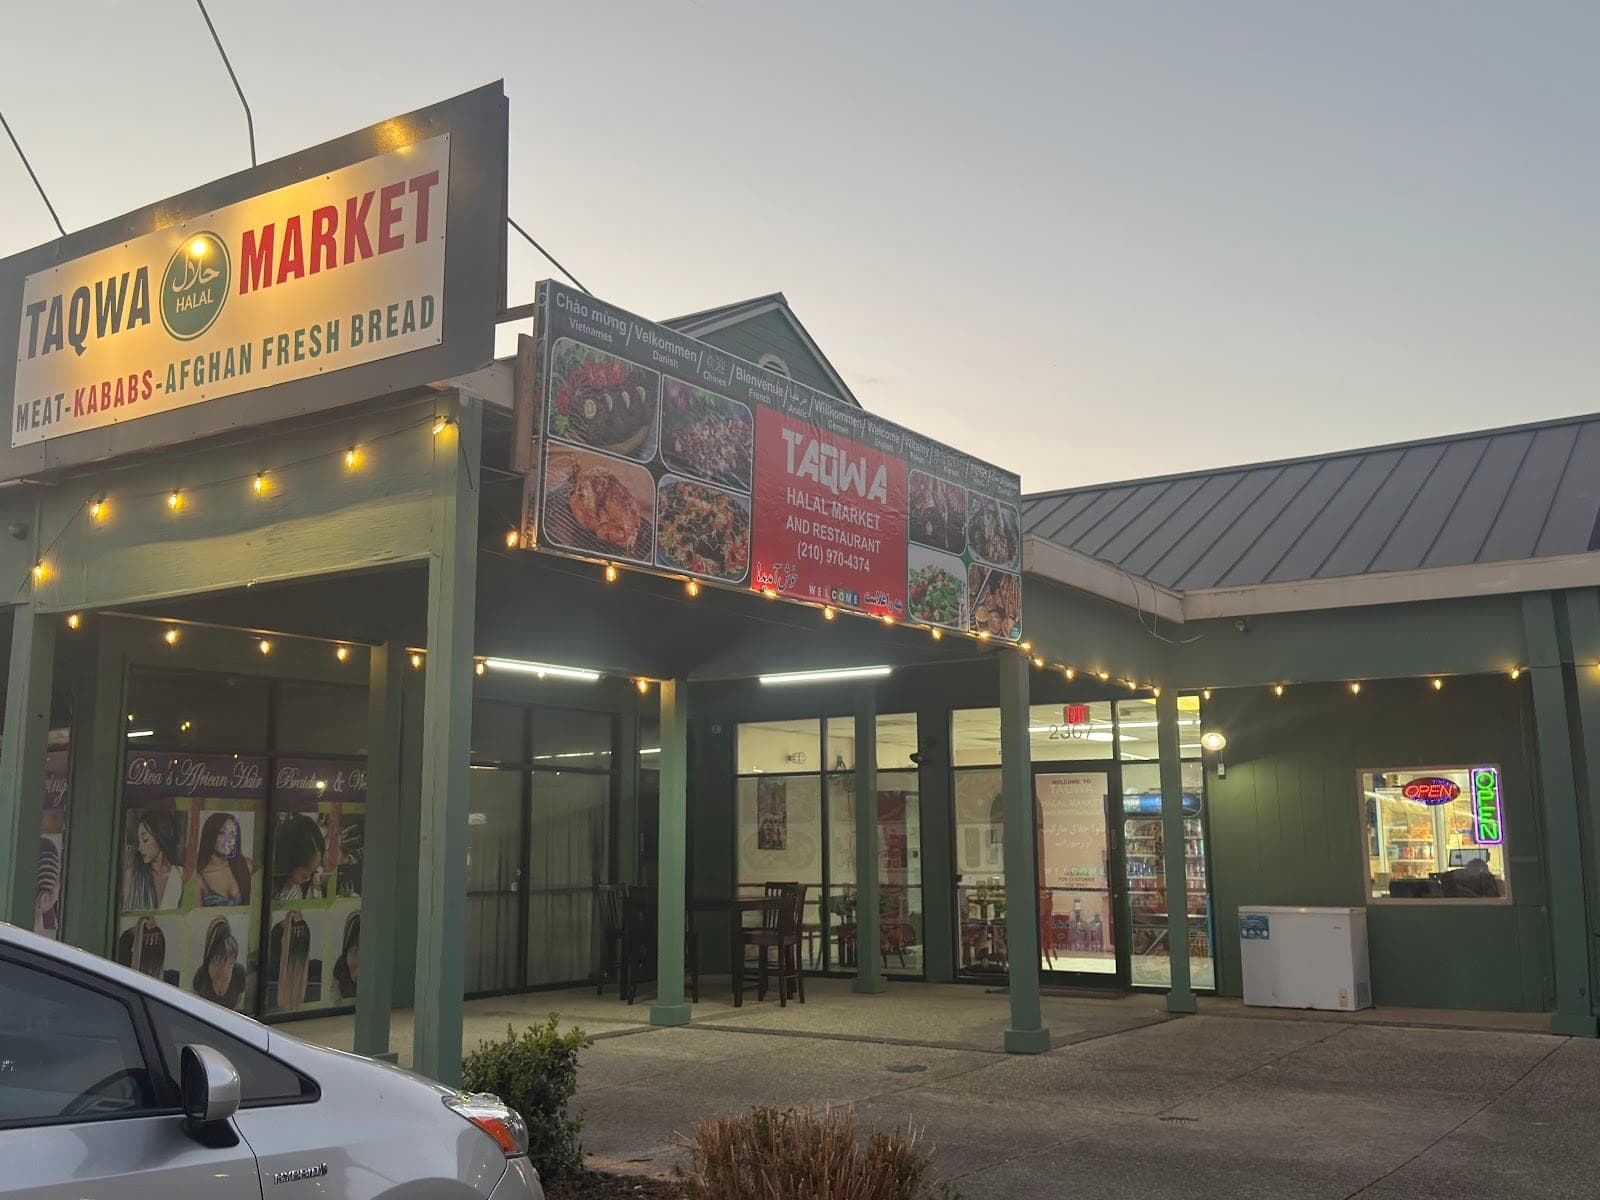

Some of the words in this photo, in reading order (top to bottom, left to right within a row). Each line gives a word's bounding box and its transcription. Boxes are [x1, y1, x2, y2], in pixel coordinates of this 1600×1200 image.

[25, 265, 151, 360] TAQWA
[239, 169, 439, 296] MARKET
[176, 288, 214, 314] HALAL
[262, 318, 341, 371] FRESH
[350, 294, 436, 348] BREAD
[652, 350, 679, 369] Danish
[782, 428, 888, 505] TAQWA
[787, 487, 829, 516] HALAL
[831, 500, 881, 531] MARKET
[786, 515, 810, 535] AND
[812, 522, 881, 553] RESTAURANT
[797, 541, 823, 565] (210)
[826, 550, 871, 573] 970-4374
[809, 584, 859, 605] WELCOME
[1067, 705, 1087, 725] EXIT
[1049, 724, 1093, 740] 2367
[276, 767, 328, 798] Braidig
[1405, 784, 1453, 798] OPEN
[1475, 772, 1498, 840] OPEN
